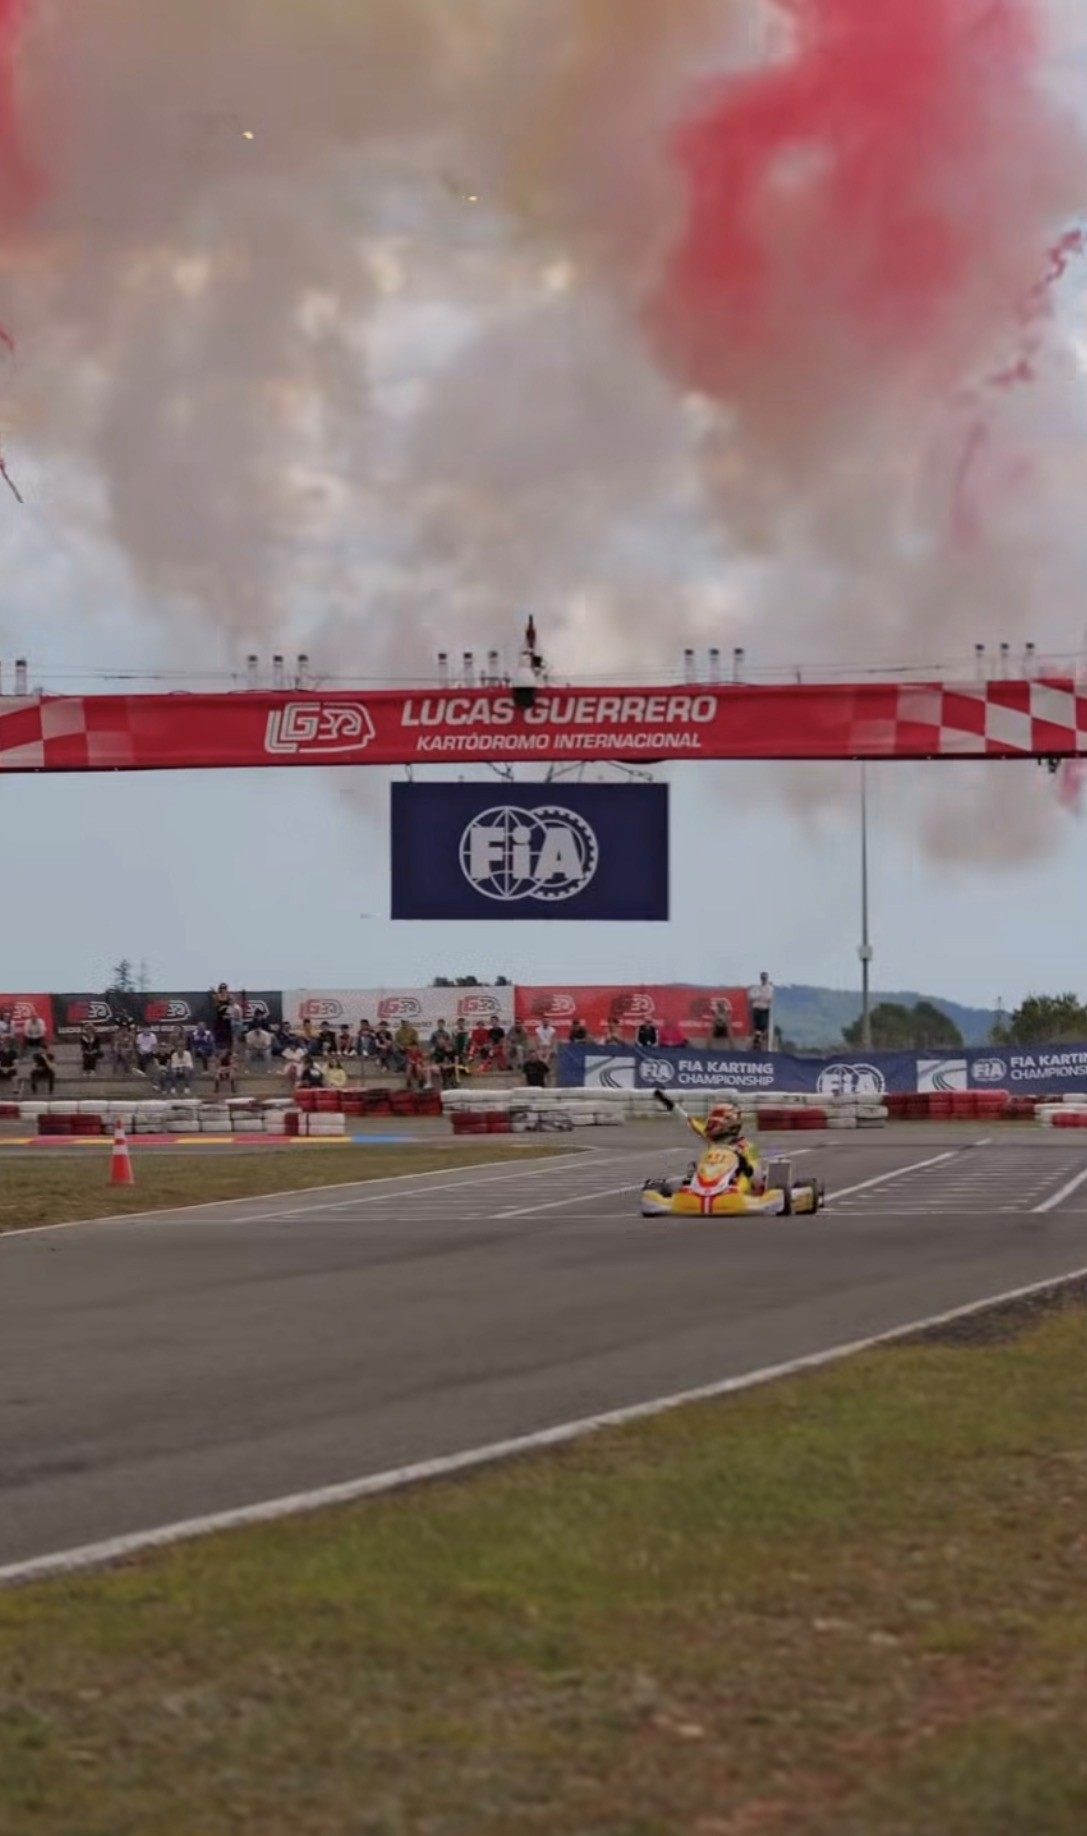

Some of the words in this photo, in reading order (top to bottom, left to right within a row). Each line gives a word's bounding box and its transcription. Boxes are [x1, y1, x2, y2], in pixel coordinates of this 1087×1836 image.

[401, 697, 515, 726] LUCAS
[524, 694, 717, 724] GUERRERO
[416, 731, 549, 751] KARTÓDROMO
[553, 732, 702, 749] INTERNACIONAL
[678, 1060, 703, 1072] FIA
[707, 1061, 774, 1074] KARTING
[1010, 1056, 1035, 1068] FIA
[678, 1073, 774, 1086] CHAMPIONSHIP
[1010, 1065, 1087, 1080] CHAMPIONS
